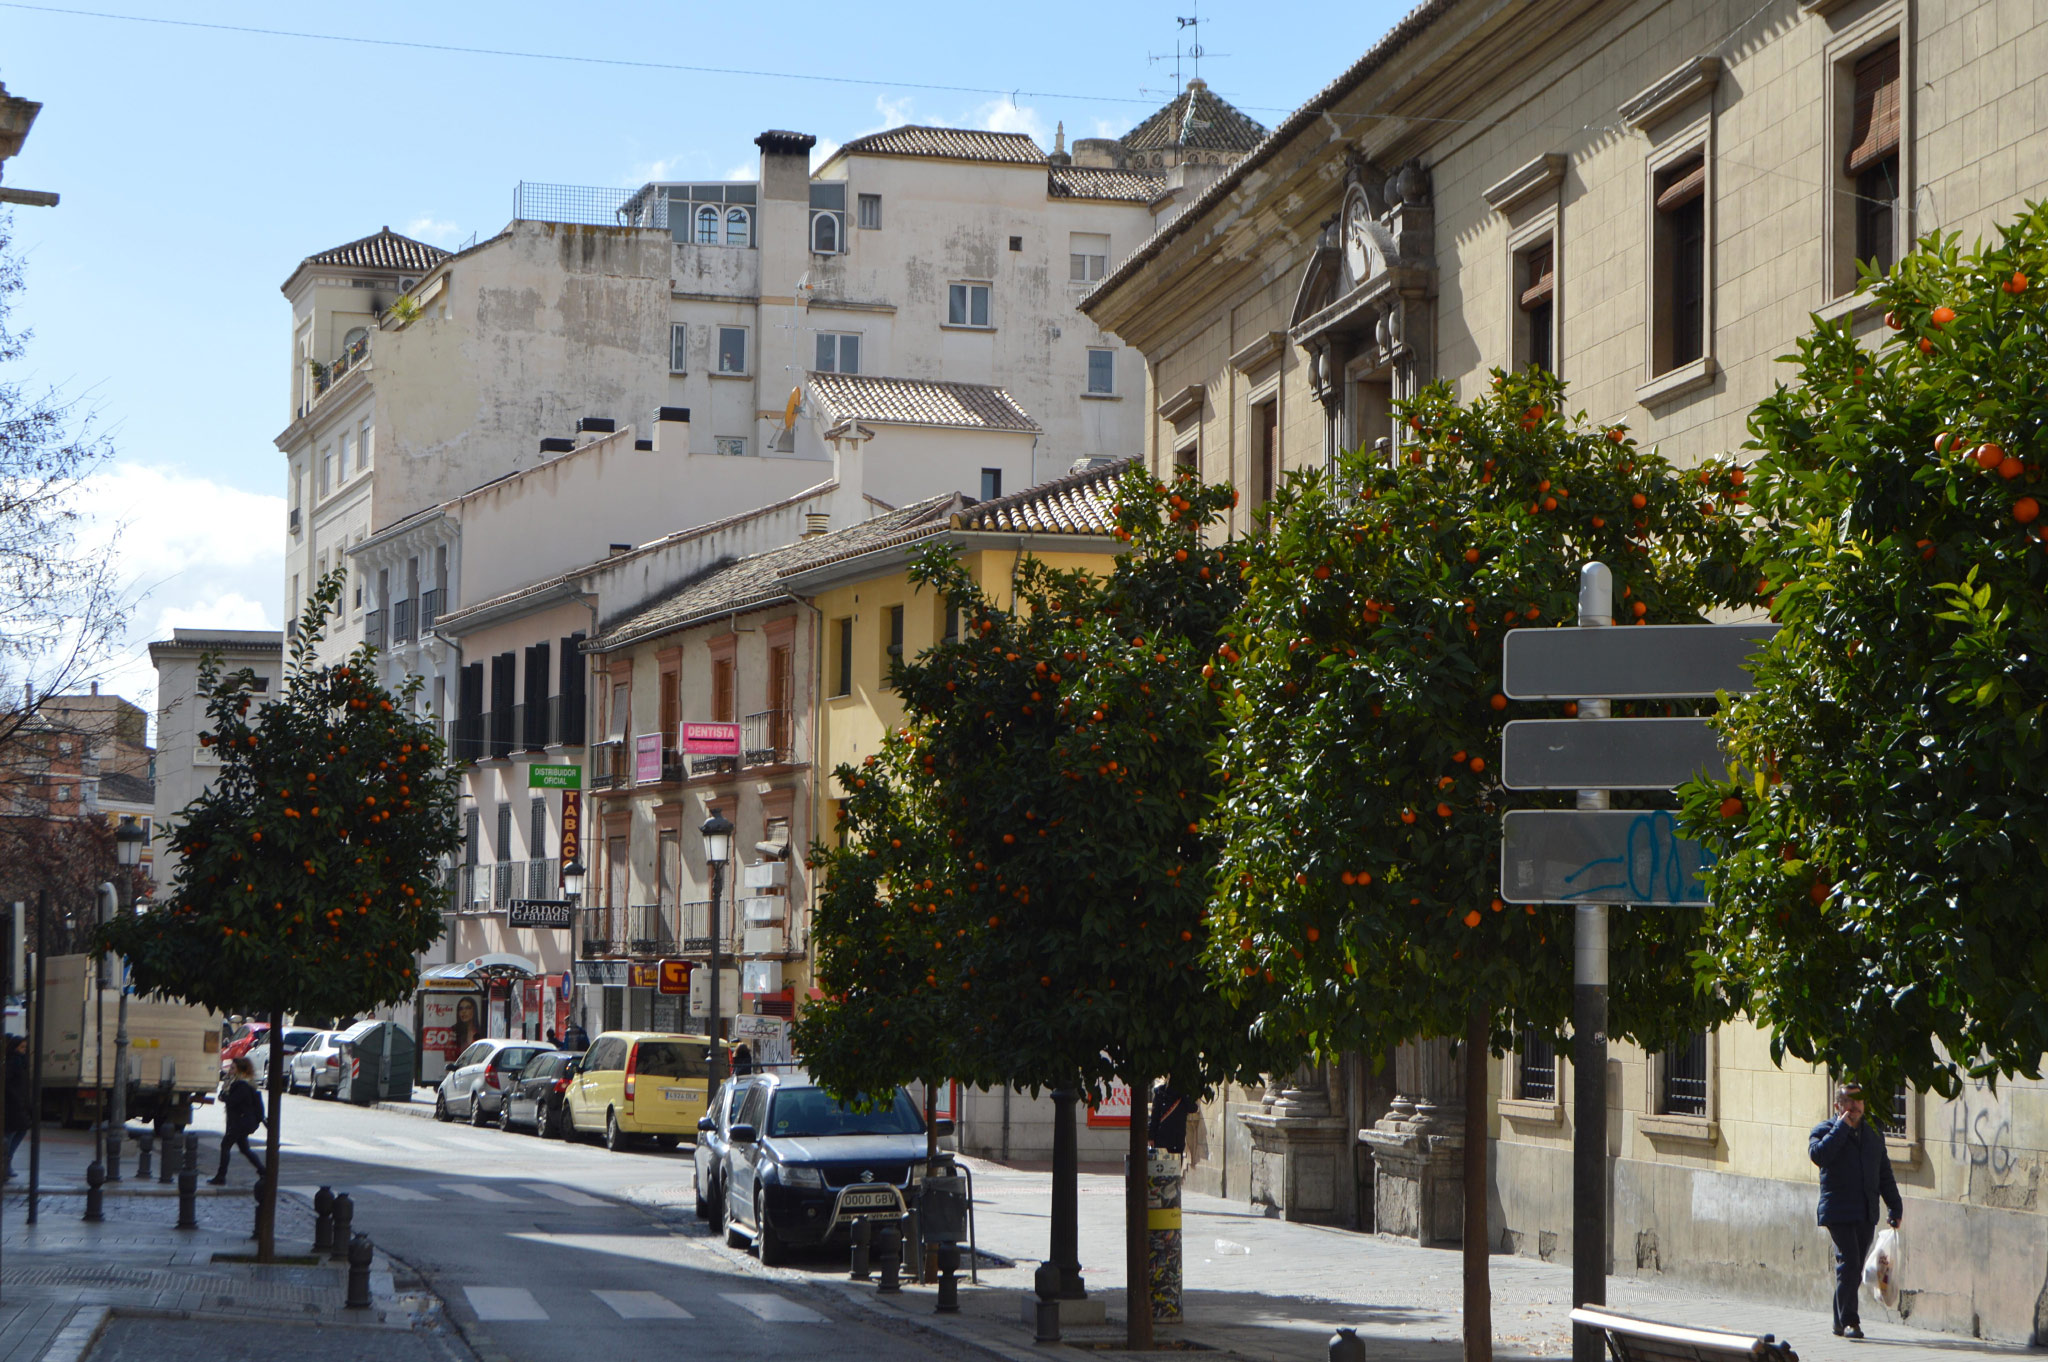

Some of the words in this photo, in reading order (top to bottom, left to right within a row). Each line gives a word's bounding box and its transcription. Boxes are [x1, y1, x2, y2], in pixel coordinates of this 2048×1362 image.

[688, 726, 734, 737] DENTISTA
[534, 768, 576, 776] DISTRIBUIDOR
[543, 776, 567, 785] OFICIAL
[511, 900, 570, 915] Pianos
[511, 911, 569, 921] Granada
[845, 1194, 871, 1206] 0000
[875, 1193, 894, 1204] GBV
